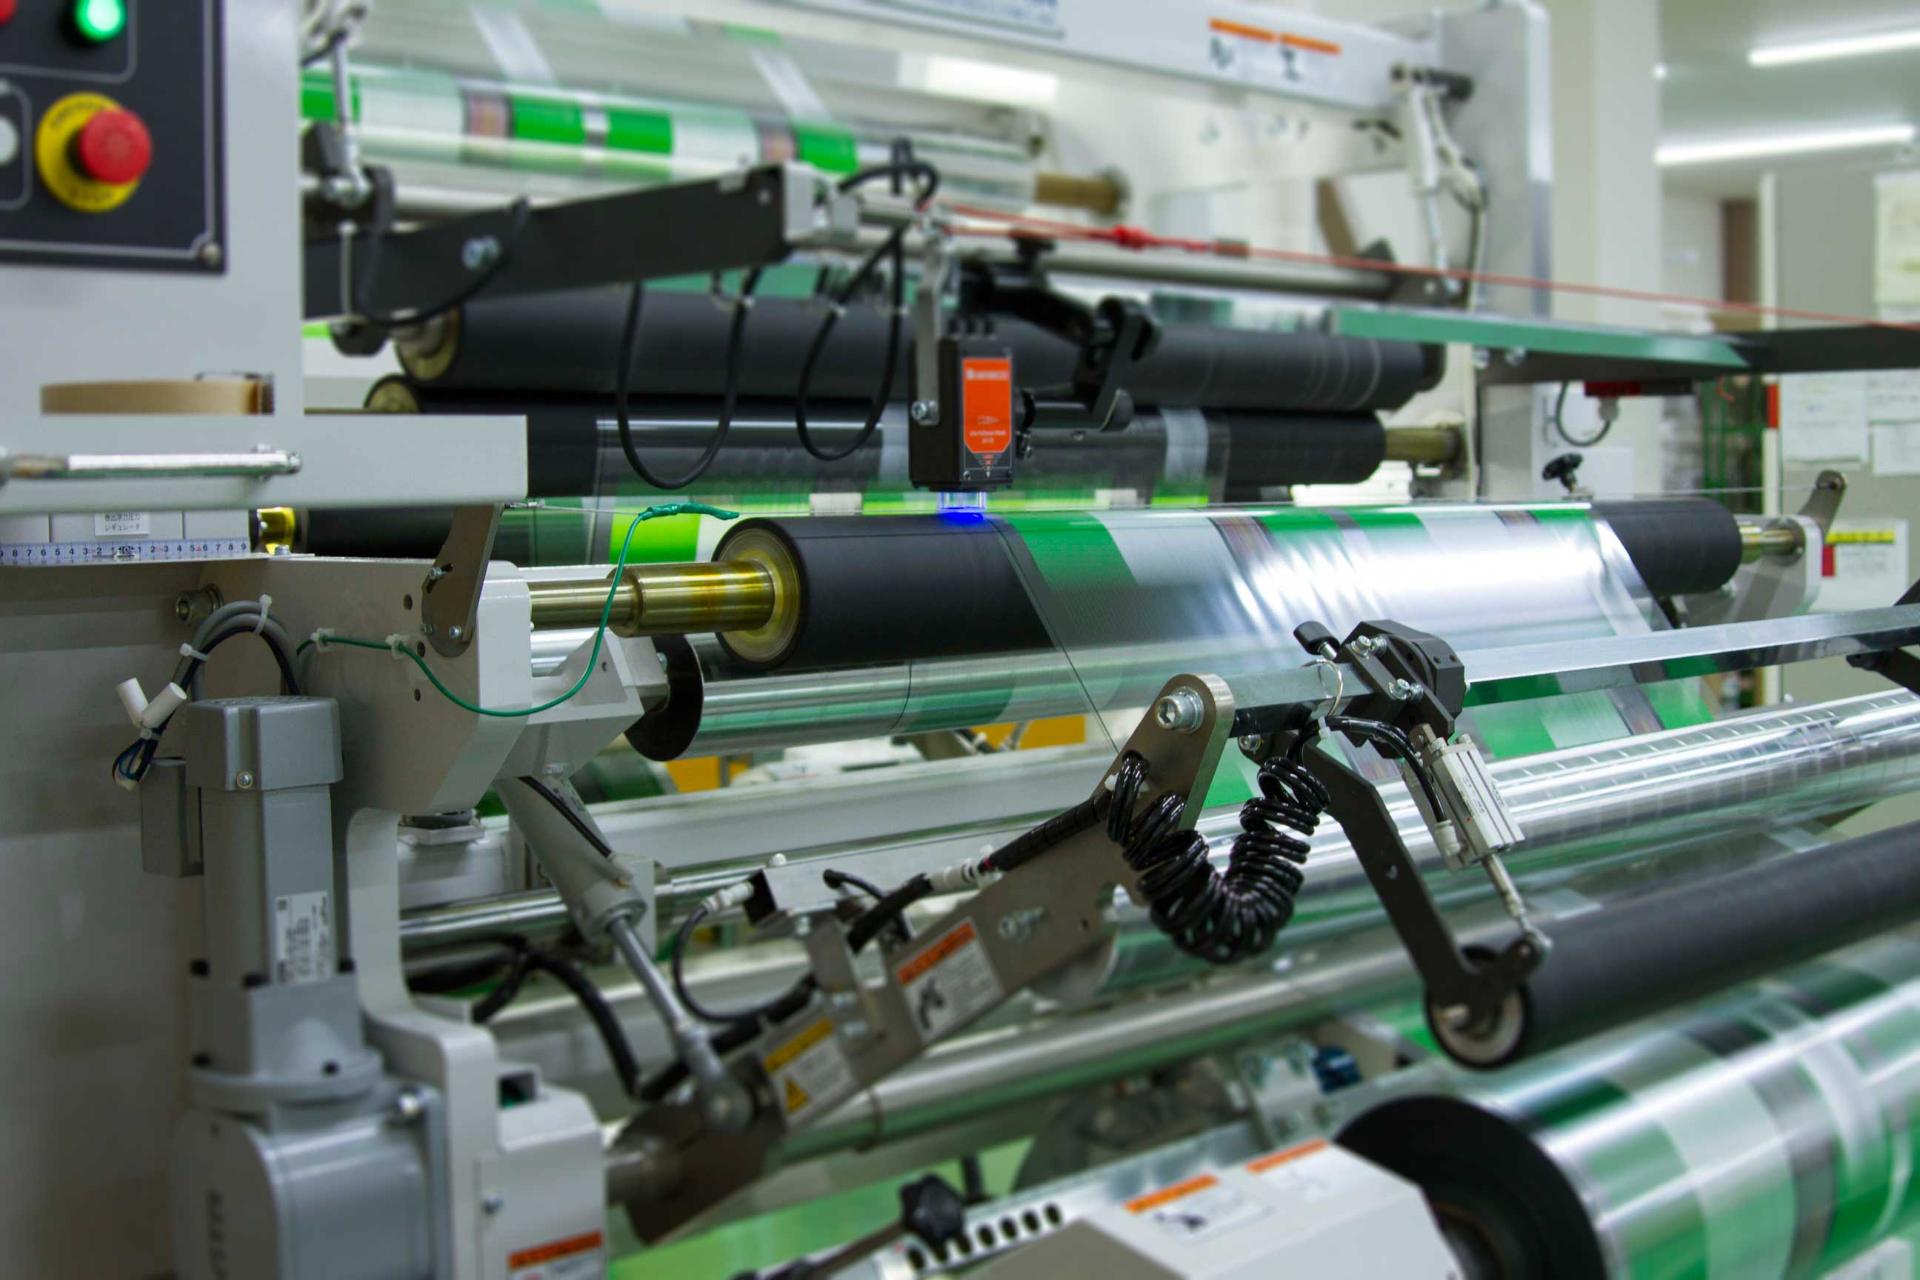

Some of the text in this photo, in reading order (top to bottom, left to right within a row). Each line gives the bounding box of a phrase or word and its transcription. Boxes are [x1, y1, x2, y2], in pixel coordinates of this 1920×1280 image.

[12, 549, 18, 557] 8
[26, 549, 32, 557] 7
[55, 548, 61, 556] 5
[68, 547, 74, 555] 4
[82, 547, 88, 555] 3
[96, 546, 102, 554] 2
[150, 545, 156, 553] 2
[176, 544, 182, 552] 4
[190, 544, 196, 552] 5
[202, 543, 208, 552] 6
[215, 543, 221, 551] 7
[228, 543, 234, 551] 8
[240, 542, 247, 550] 9
